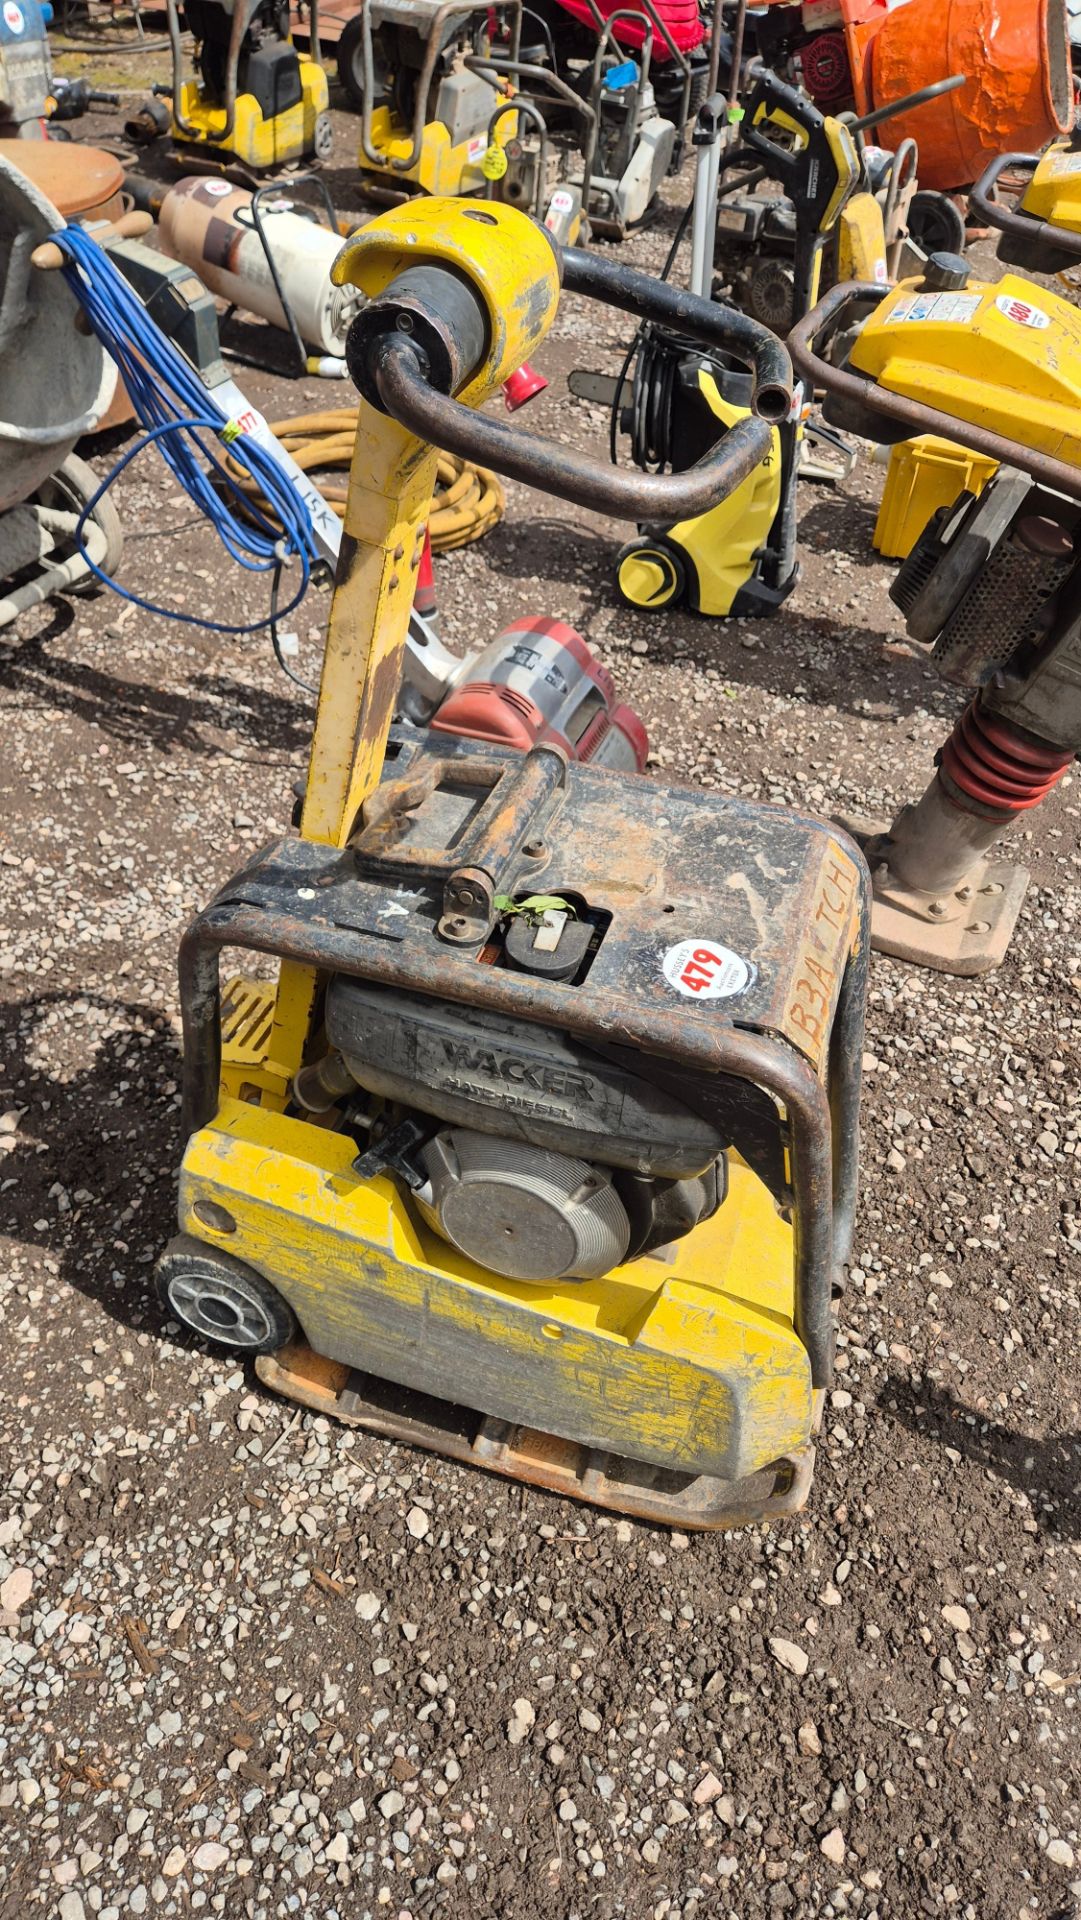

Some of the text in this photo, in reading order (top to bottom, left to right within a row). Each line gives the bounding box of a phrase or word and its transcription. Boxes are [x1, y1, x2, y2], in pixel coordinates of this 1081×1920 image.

[1008, 302, 1032, 323] 480
[670, 948, 690, 978] HUSSEYS
[680, 948, 723, 992] 479
[440, 1037, 595, 1103] WACKER
